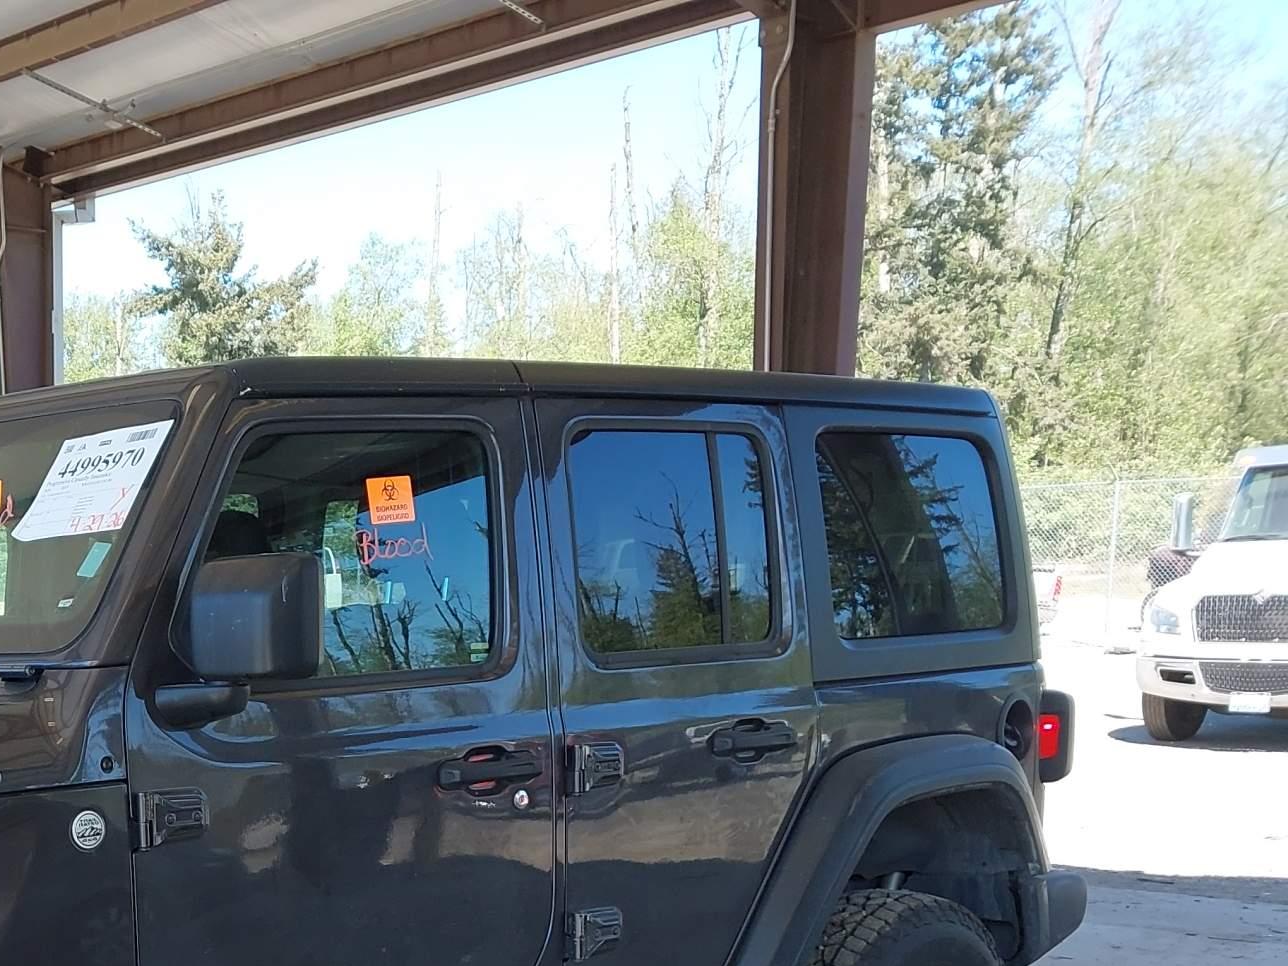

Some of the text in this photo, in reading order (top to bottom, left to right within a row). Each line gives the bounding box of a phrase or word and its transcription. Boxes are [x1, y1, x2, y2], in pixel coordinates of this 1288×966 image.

[58, 447, 145, 479] 44995970
[375, 503, 408, 513] BIOHAZARD
[353, 522, 434, 565] Blood
